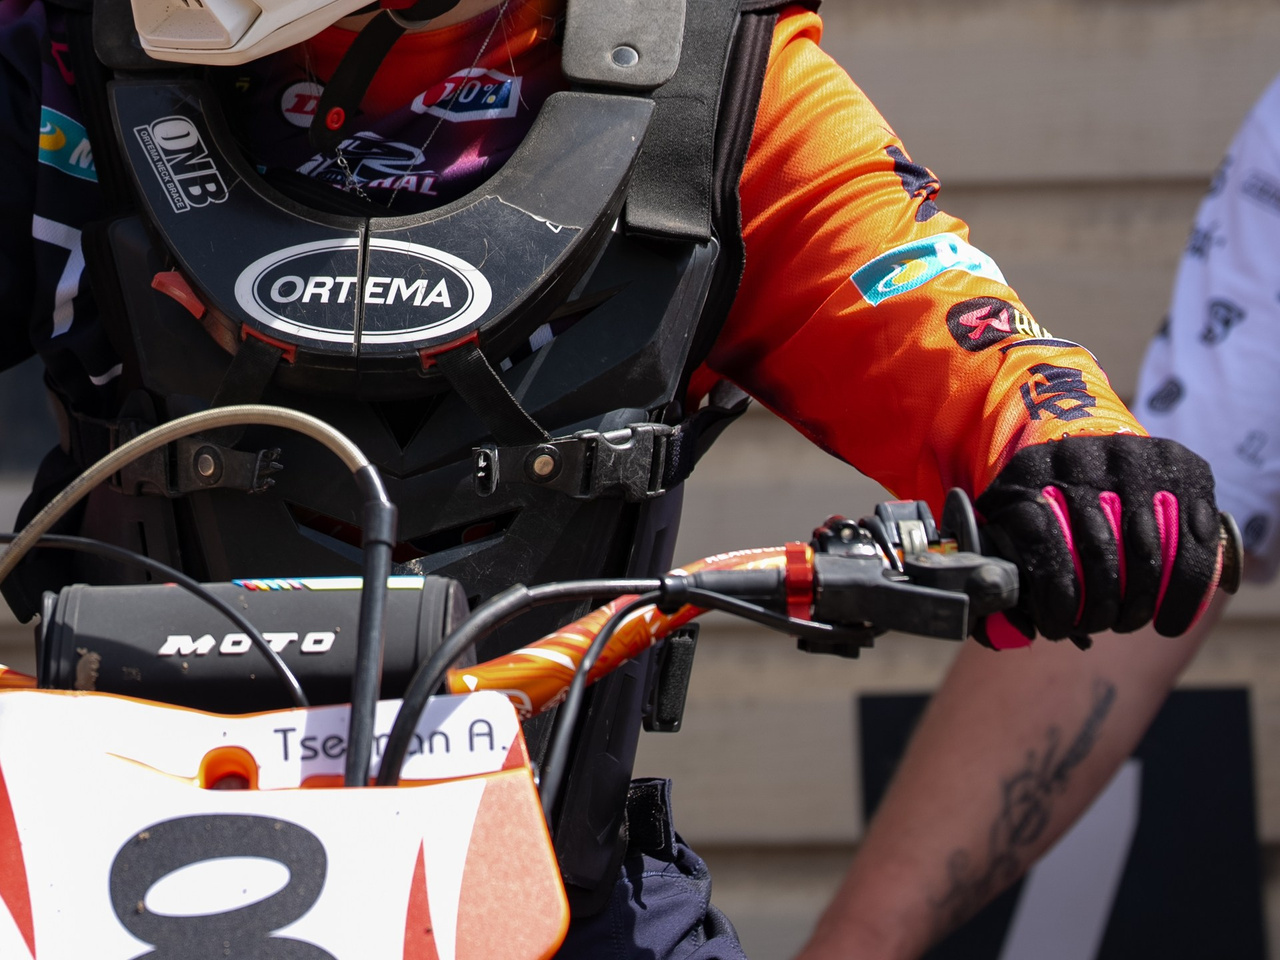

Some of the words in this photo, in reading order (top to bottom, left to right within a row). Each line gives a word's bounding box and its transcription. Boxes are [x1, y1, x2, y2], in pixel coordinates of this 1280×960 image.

[140, 130, 161, 162] ORTEMA
[155, 161, 172, 183] NECK
[166, 182, 185, 209] BRACE
[150, 115, 229, 207] ONB
[270, 275, 452, 308] ORTEMA
[157, 631, 336, 656] MOTO
